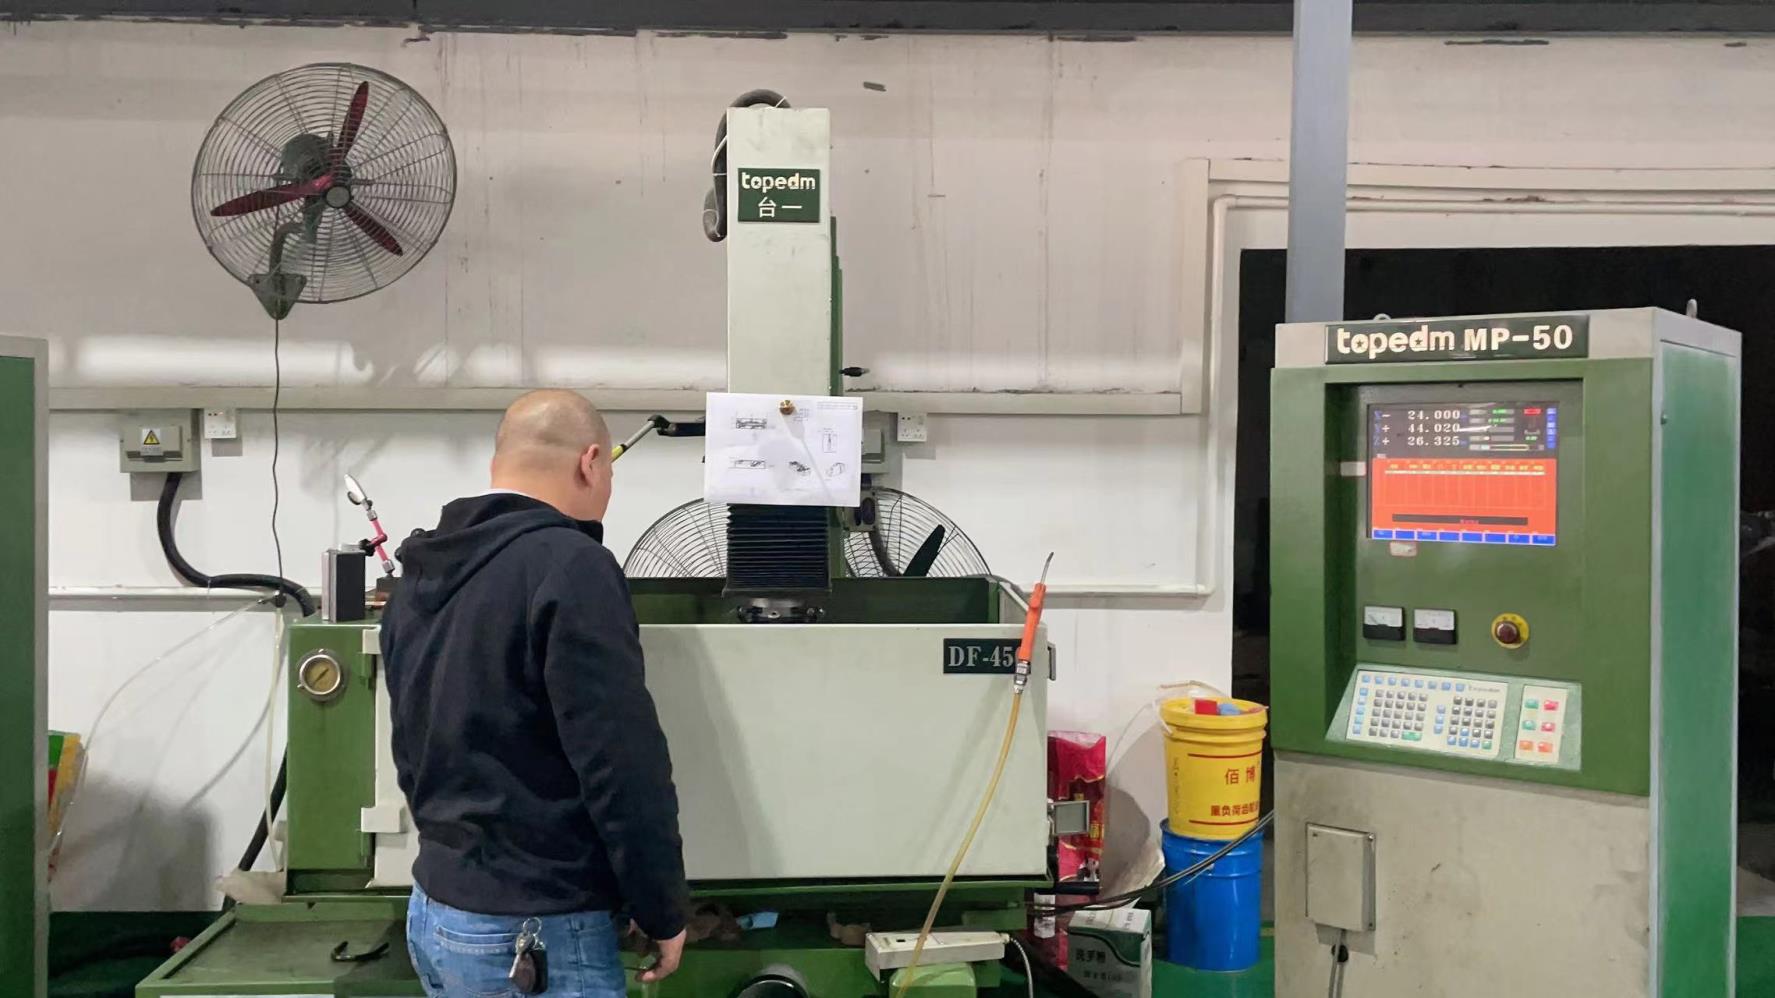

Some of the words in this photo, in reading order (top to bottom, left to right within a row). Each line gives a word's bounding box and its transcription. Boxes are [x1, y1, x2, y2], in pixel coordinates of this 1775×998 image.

[741, 172, 816, 193] topedm
[757, 196, 803, 218] 台一
[1336, 325, 1455, 359] topedm
[1464, 325, 1573, 351] MP-50
[1407, 410, 1461, 420] 24.000
[1407, 423, 1461, 433] 44.020
[1407, 436, 1461, 446] 26.325
